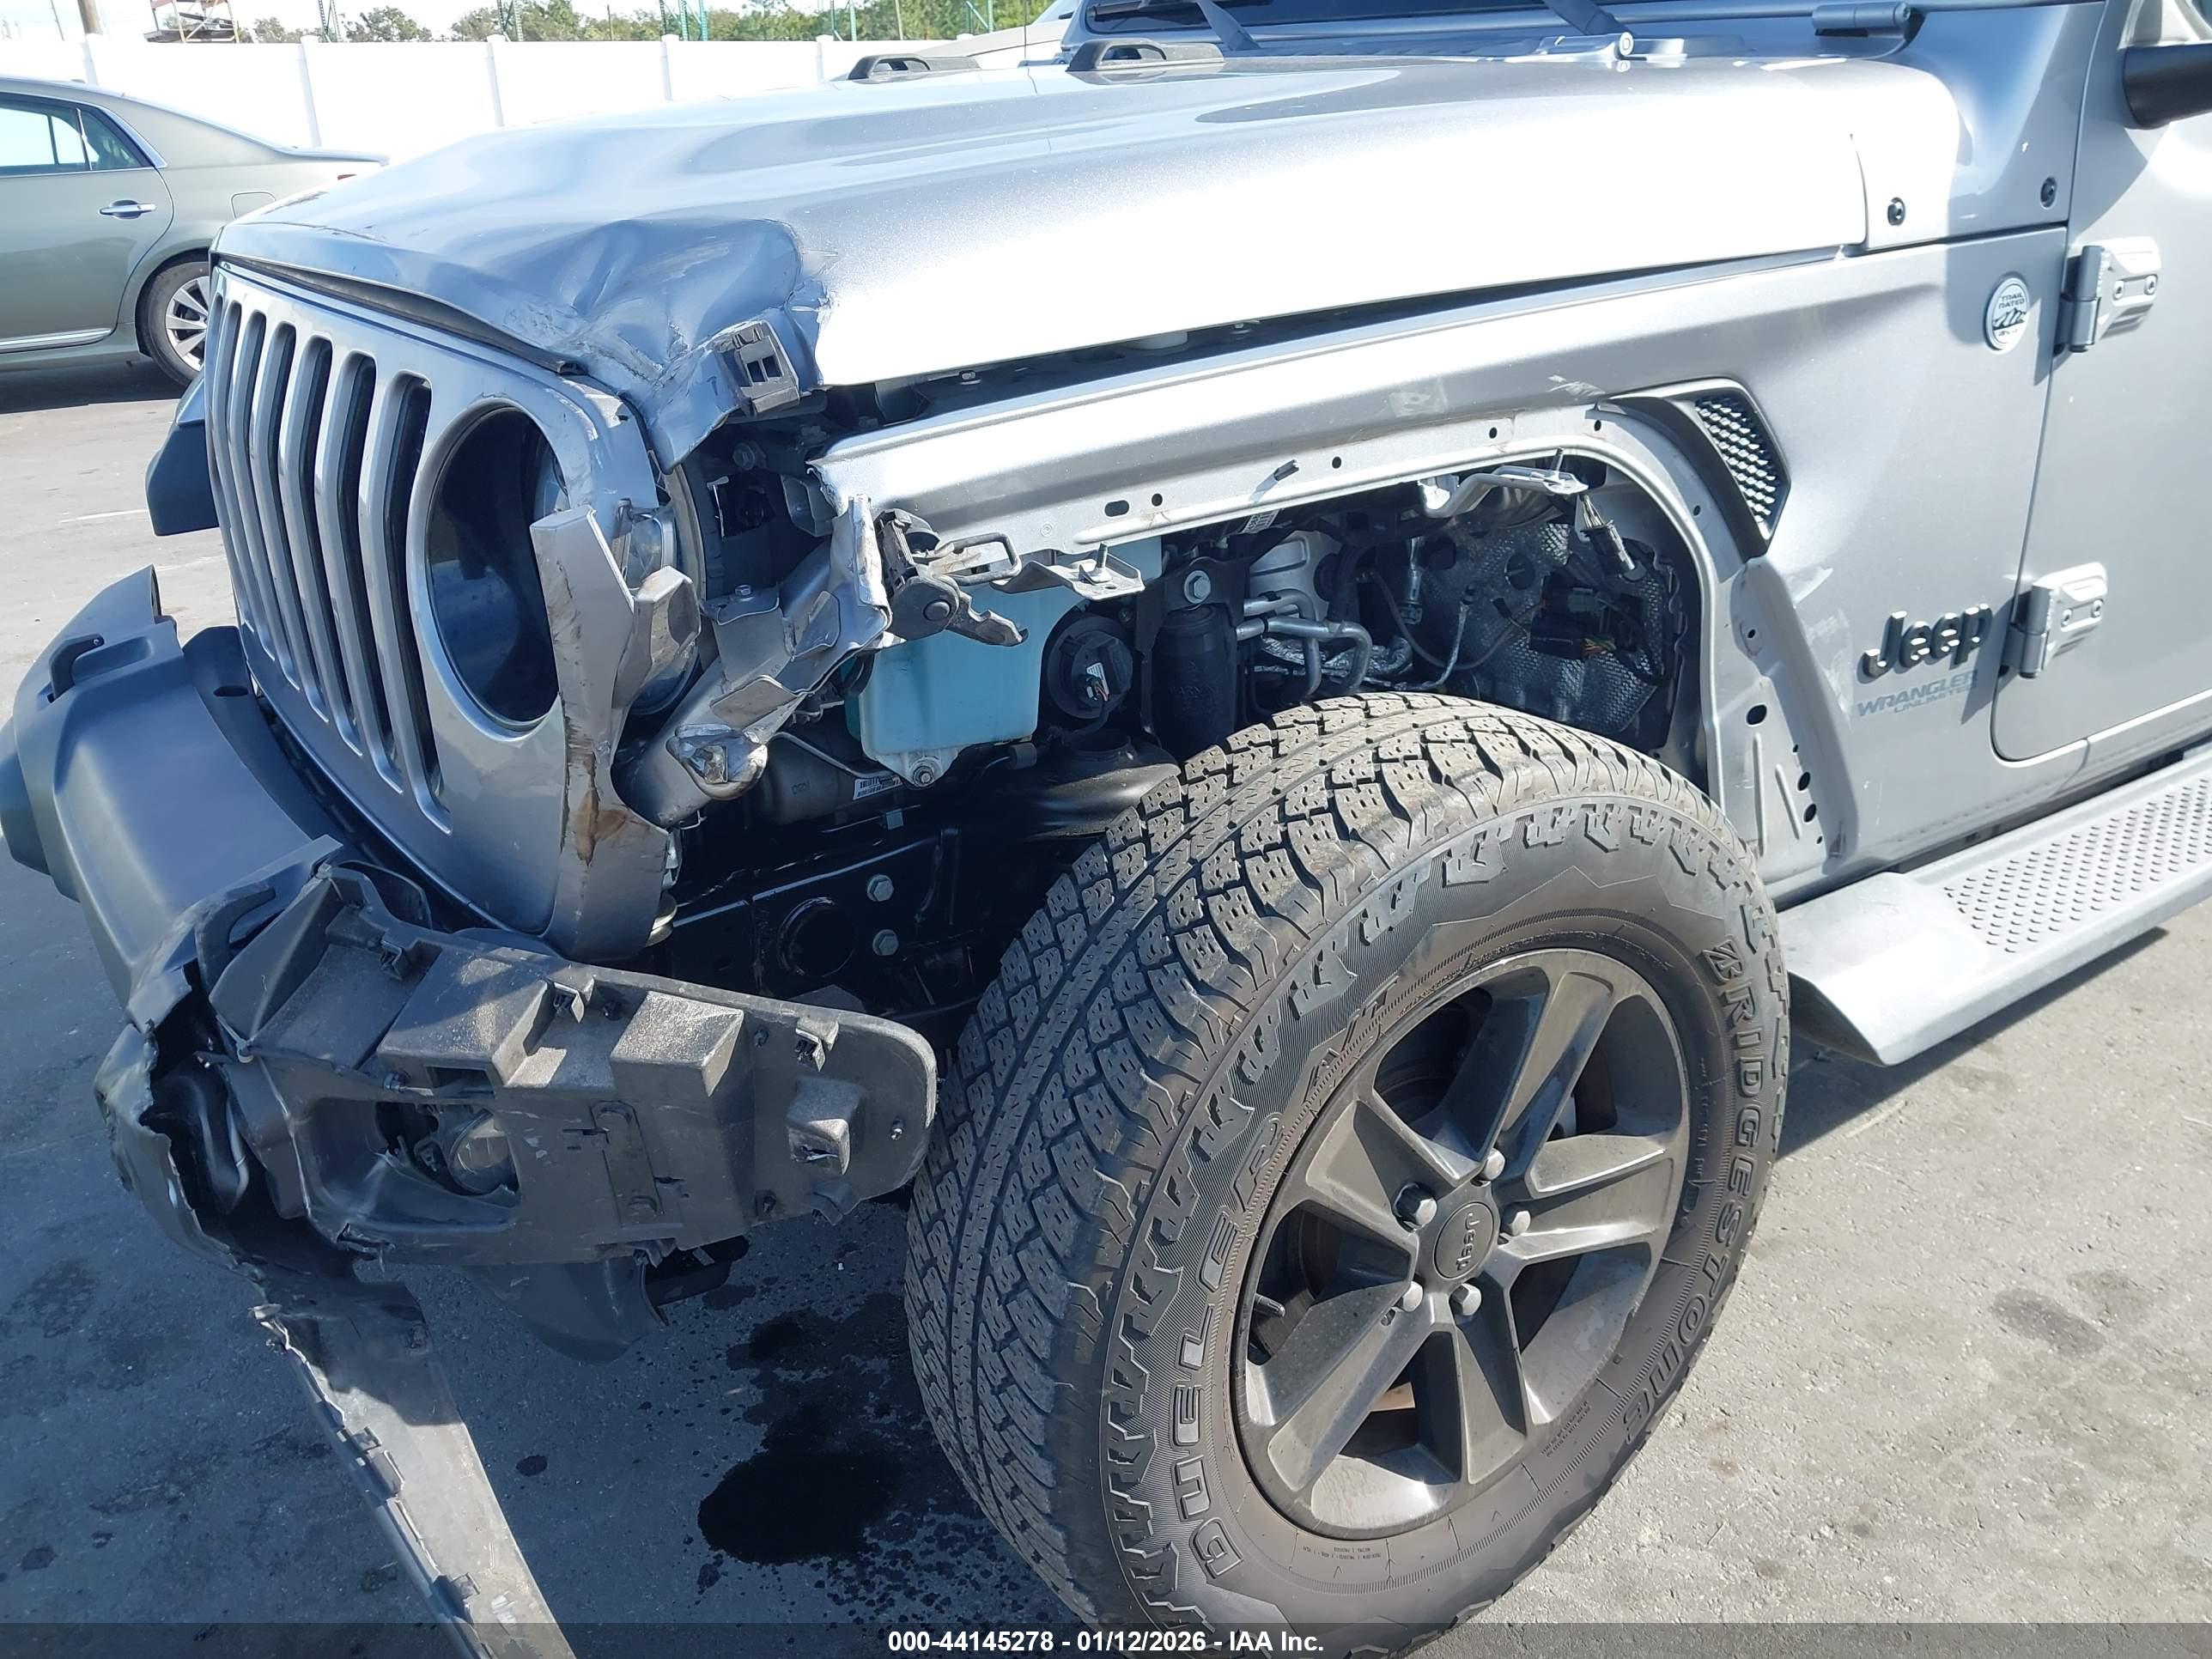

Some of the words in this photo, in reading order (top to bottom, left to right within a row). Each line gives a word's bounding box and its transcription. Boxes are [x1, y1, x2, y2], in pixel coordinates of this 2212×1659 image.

[1859, 604, 1993, 680] Jeep
[1857, 670, 1978, 716] WRANGLER
[1893, 686, 1972, 714] UNLIMITE
[1623, 940, 1762, 1444] BRIDGESTONE
[1455, 1212, 1480, 1271] Jeep
[1173, 1113, 1285, 1579] DUELER
